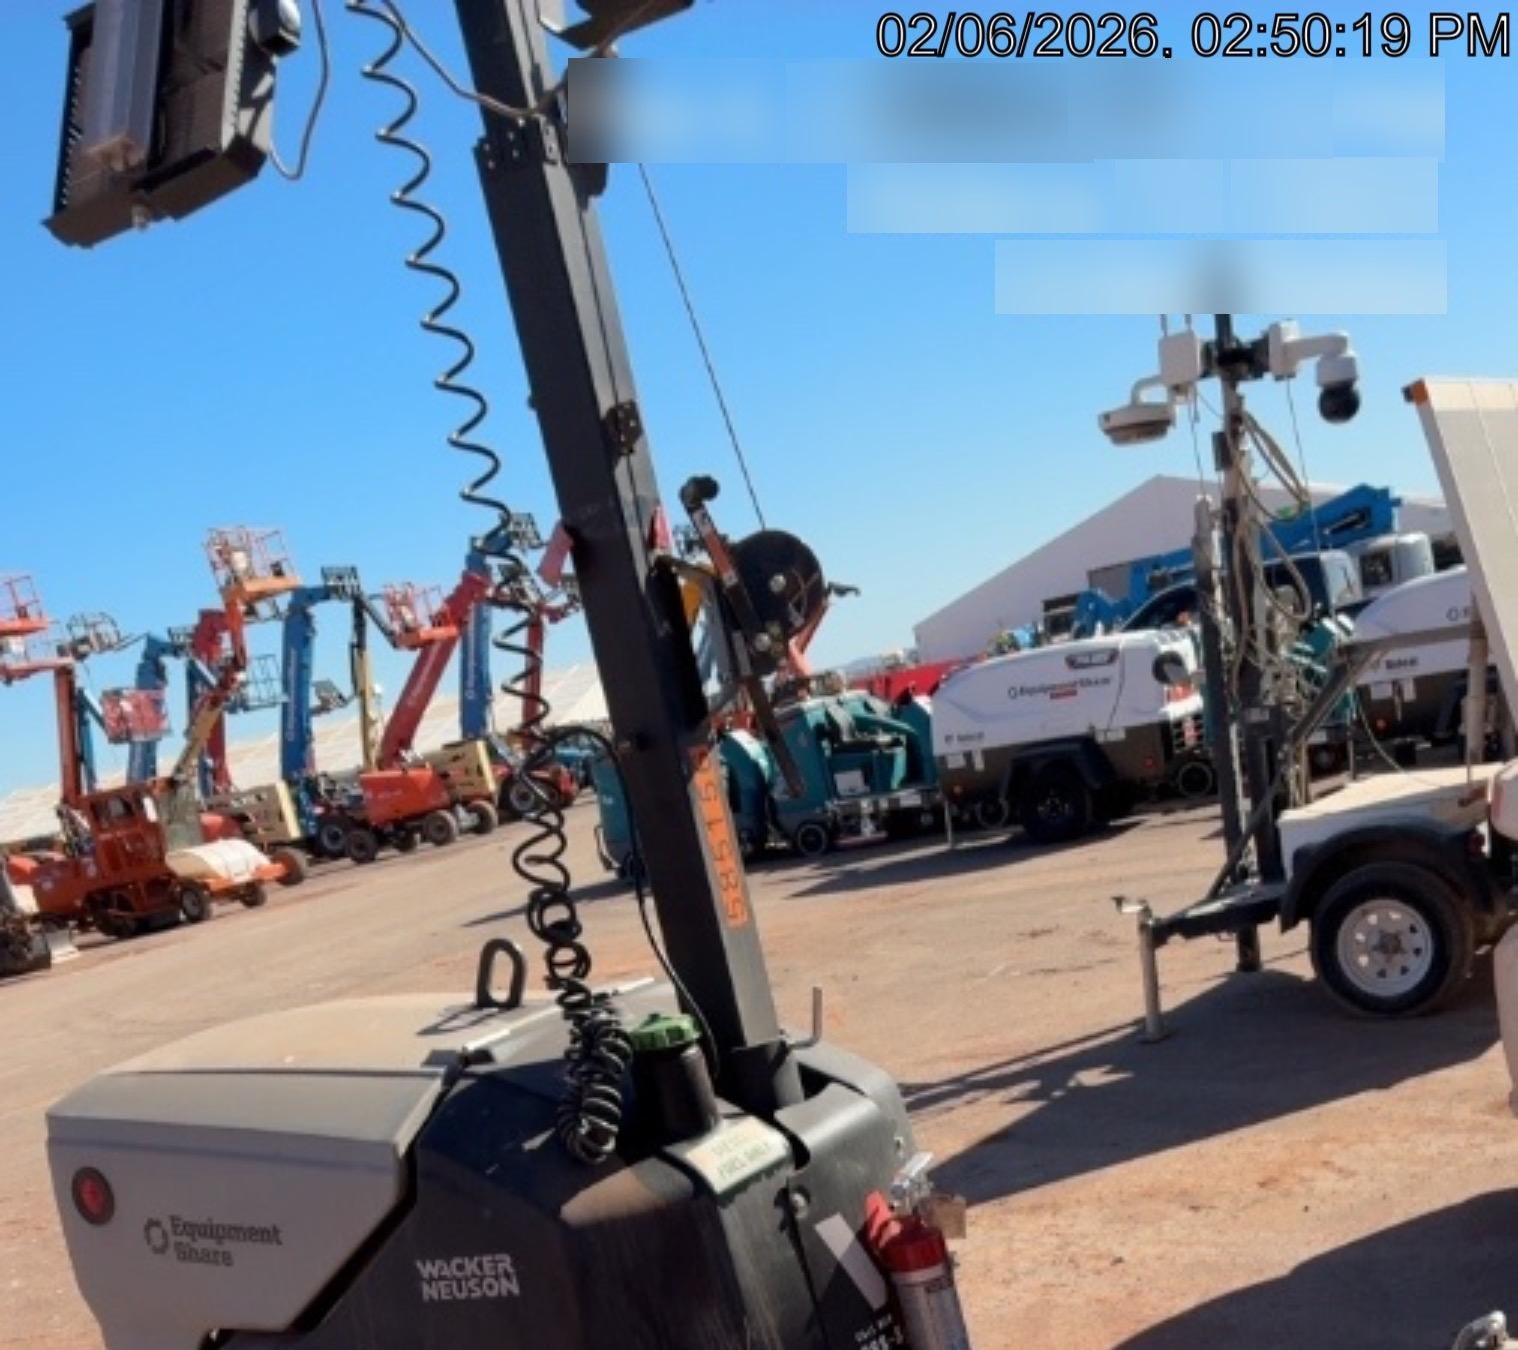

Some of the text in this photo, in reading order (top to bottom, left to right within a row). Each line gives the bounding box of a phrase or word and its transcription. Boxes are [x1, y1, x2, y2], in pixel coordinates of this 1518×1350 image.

[169, 1214, 283, 1246] Equipment
[173, 1241, 234, 1267] Share
[415, 1254, 515, 1280] WACKER
[422, 1276, 520, 1302] NEUSON
